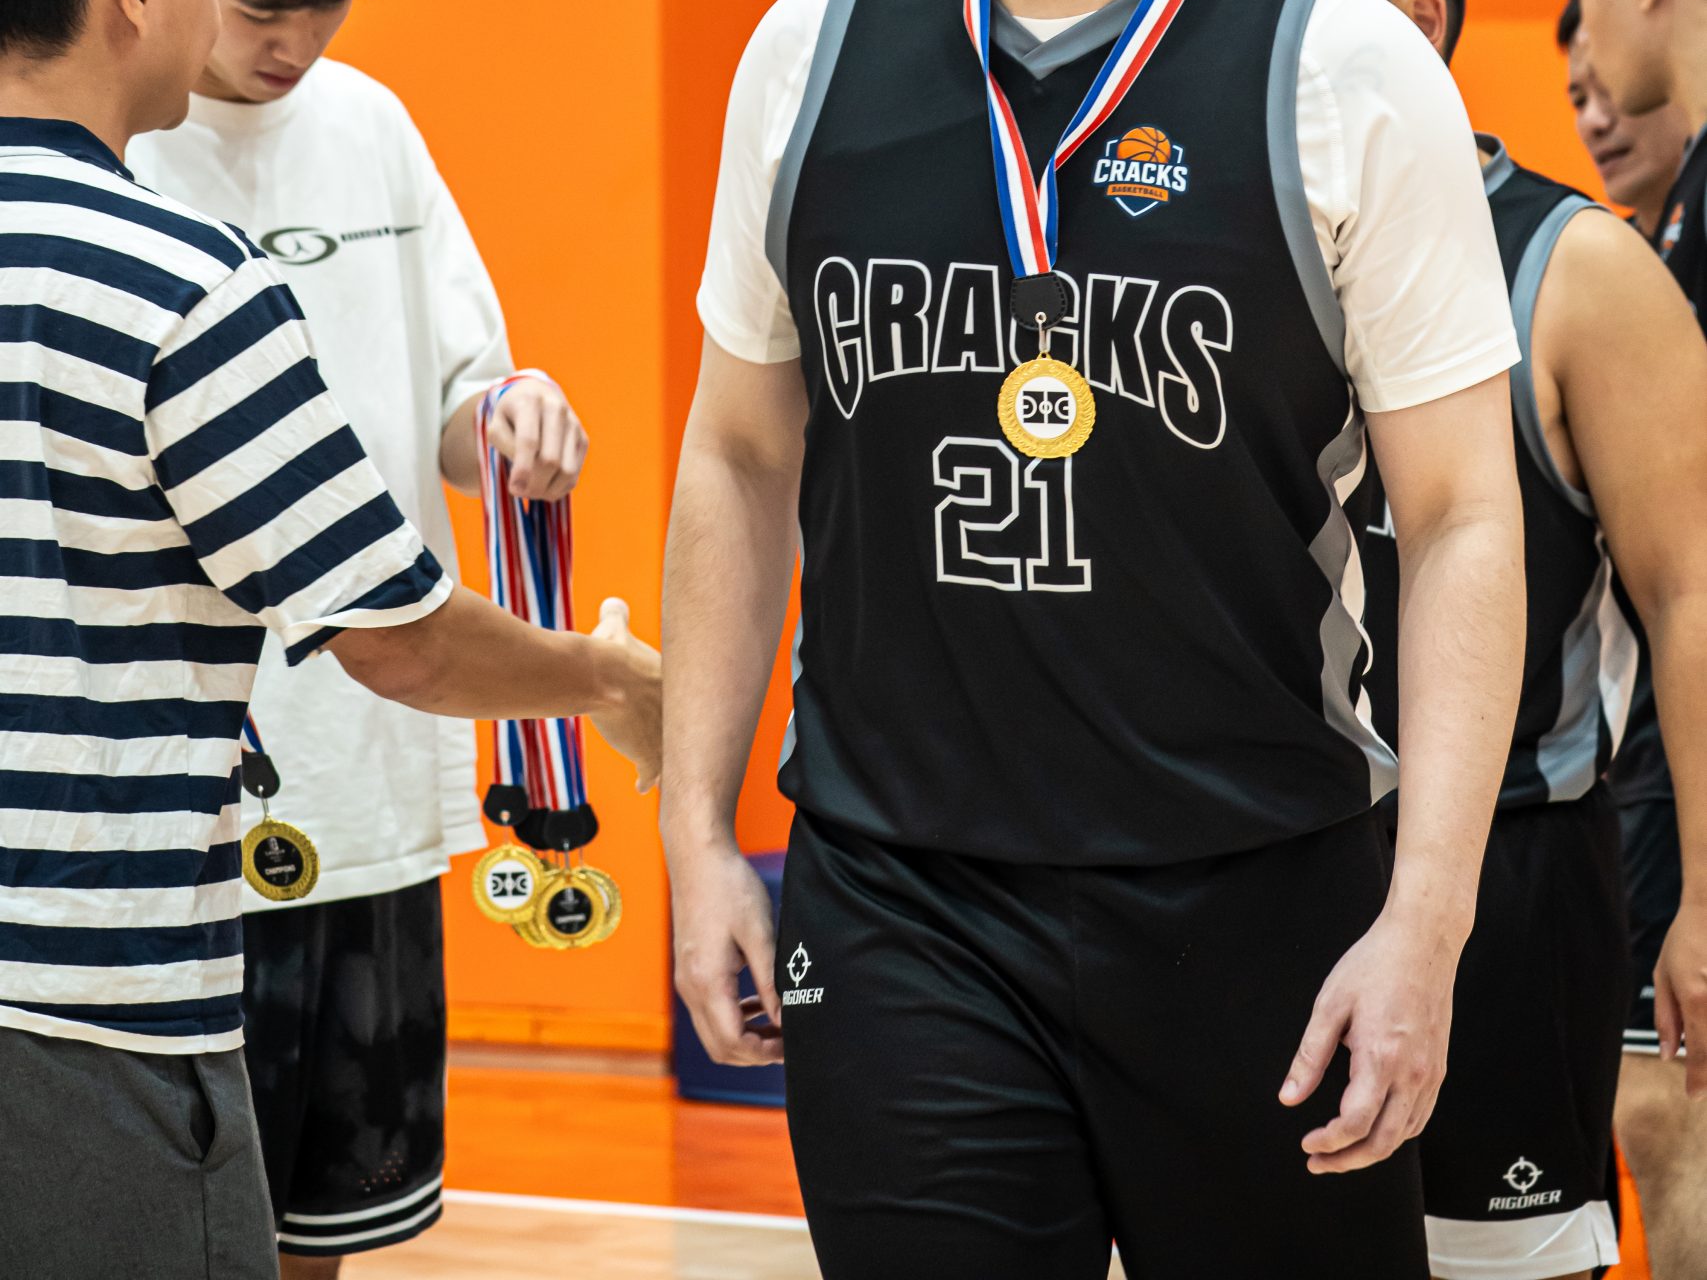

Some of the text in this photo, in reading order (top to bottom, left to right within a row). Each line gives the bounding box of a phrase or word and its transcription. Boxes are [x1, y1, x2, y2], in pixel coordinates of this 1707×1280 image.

[1093, 158, 1188, 192] CRACKS
[1111, 185, 1164, 199] BASKETBALL
[932, 436, 1092, 592] 21
[1488, 1189, 1562, 1212] RIGORER
